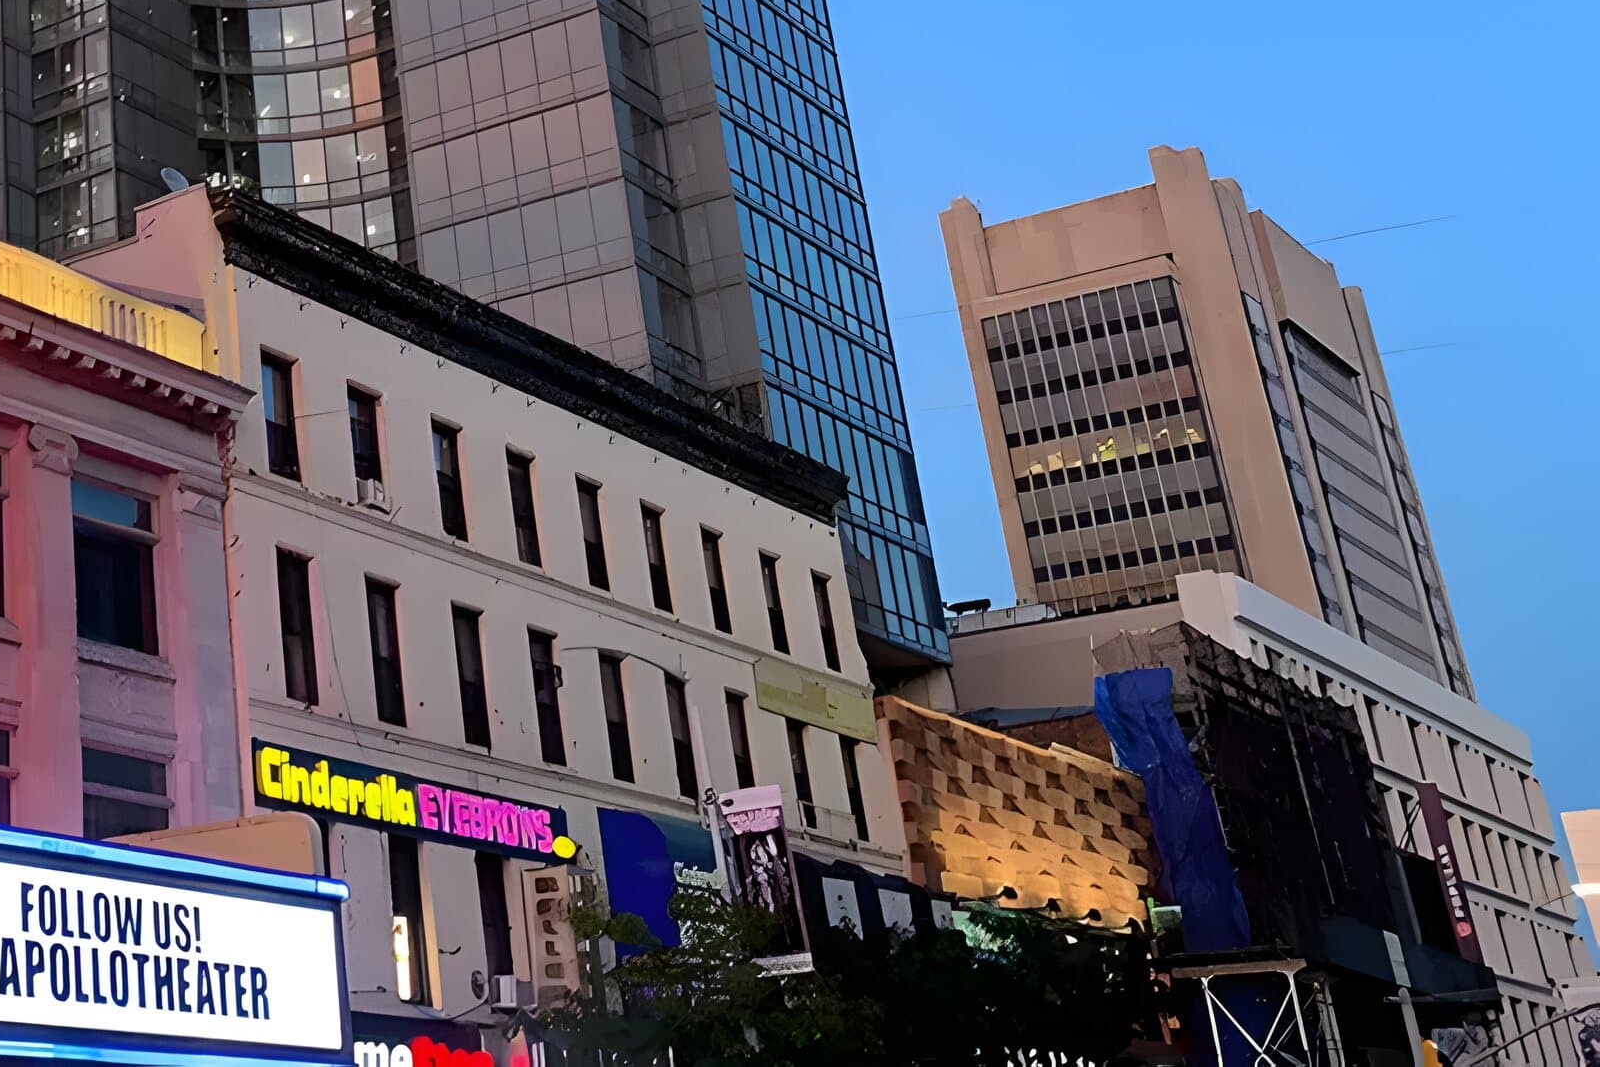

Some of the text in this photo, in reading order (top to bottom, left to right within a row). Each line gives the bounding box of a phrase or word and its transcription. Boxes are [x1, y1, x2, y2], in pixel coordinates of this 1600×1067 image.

[257, 746, 554, 854] Cinderella EYEBROWS
[20, 881, 203, 954] FOLLOW US!
